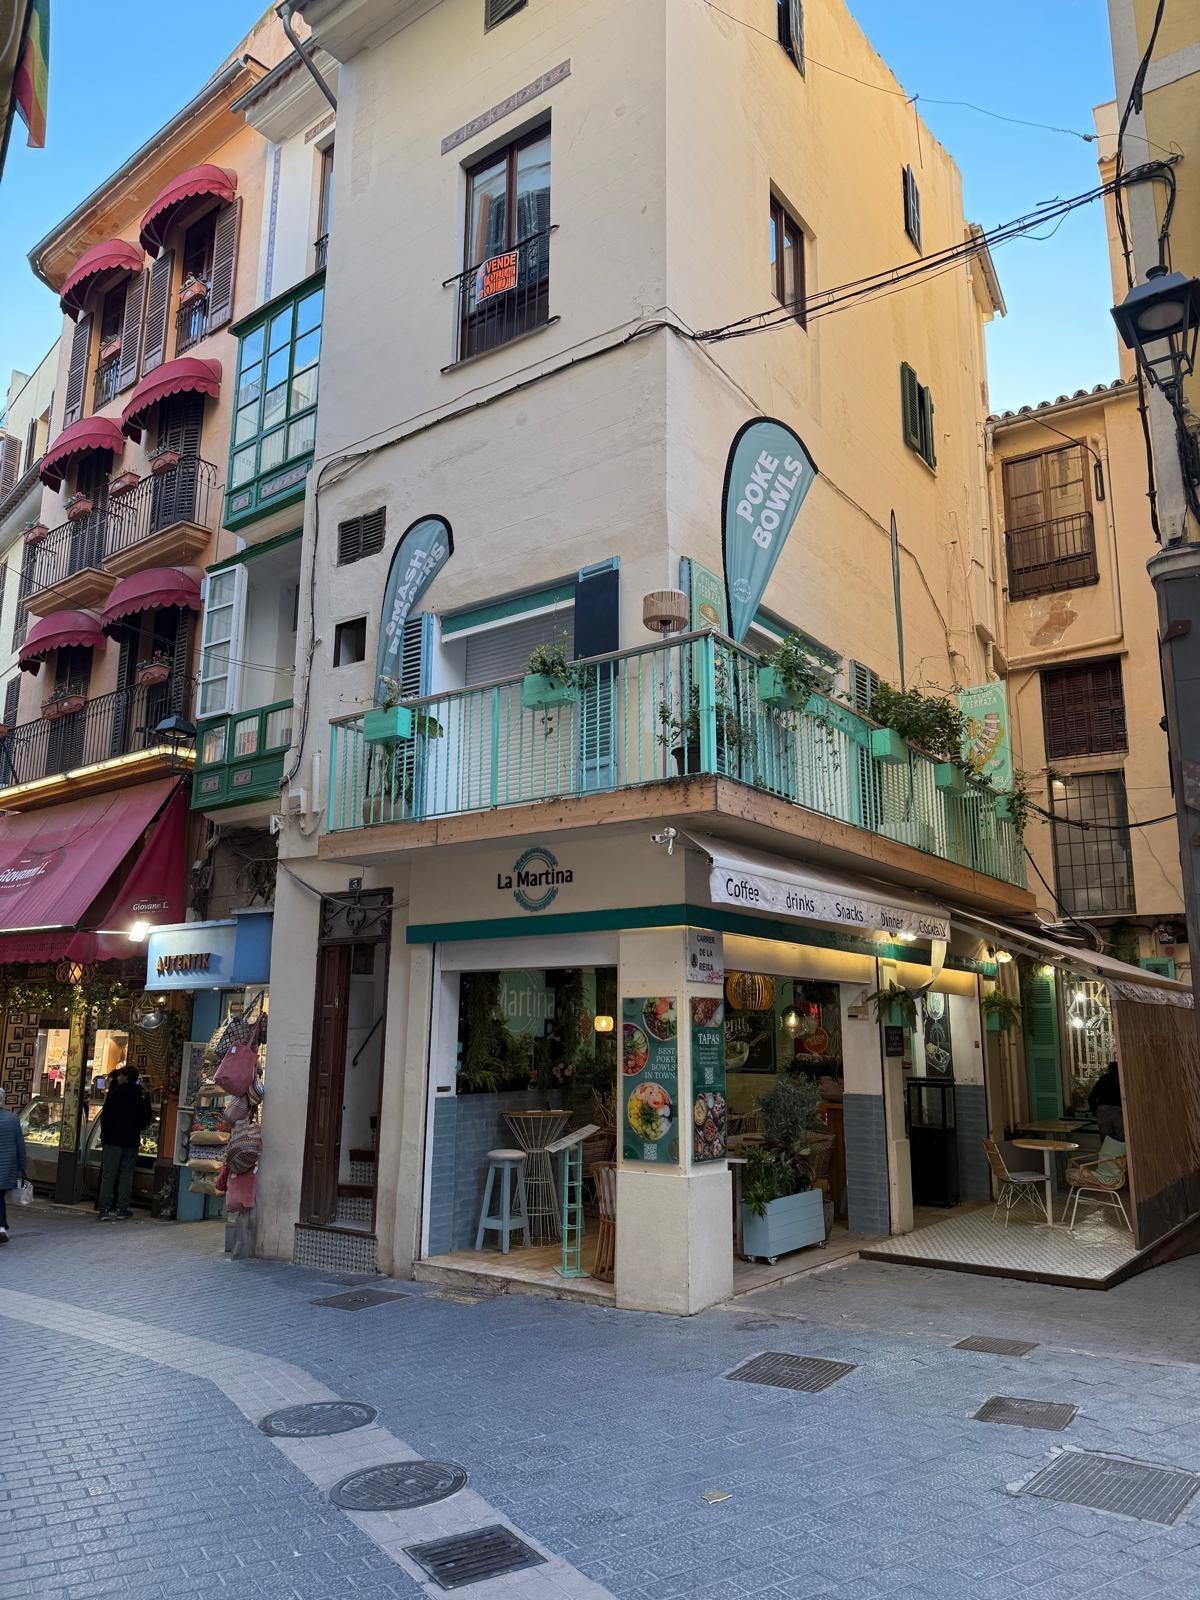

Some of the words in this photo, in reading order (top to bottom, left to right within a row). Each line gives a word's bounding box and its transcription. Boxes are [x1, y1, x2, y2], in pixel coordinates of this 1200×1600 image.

[487, 253, 517, 273] VENDE
[736, 449, 779, 523] POKE
[752, 455, 803, 549] BOWLS
[497, 873, 512, 889] La
[517, 868, 573, 887] Martina
[726, 878, 759, 902] Coffee
[786, 892, 815, 912] drinks
[836, 902, 863, 922] Snacks
[881, 912, 903, 930] Dinner
[696, 934, 716, 944] CARRER
[699, 948, 706, 957] DE
[706, 949, 713, 957] LA
[156, 953, 208, 971] AUTENTIK
[697, 1033, 720, 1045] TAPAS
[658, 1047, 676, 1055] BEST
[656, 1055, 676, 1063] POKE
[651, 1063, 676, 1071] BOWLS
[644, 1071, 655, 1079] IN
[655, 1071, 676, 1079] TOWN
